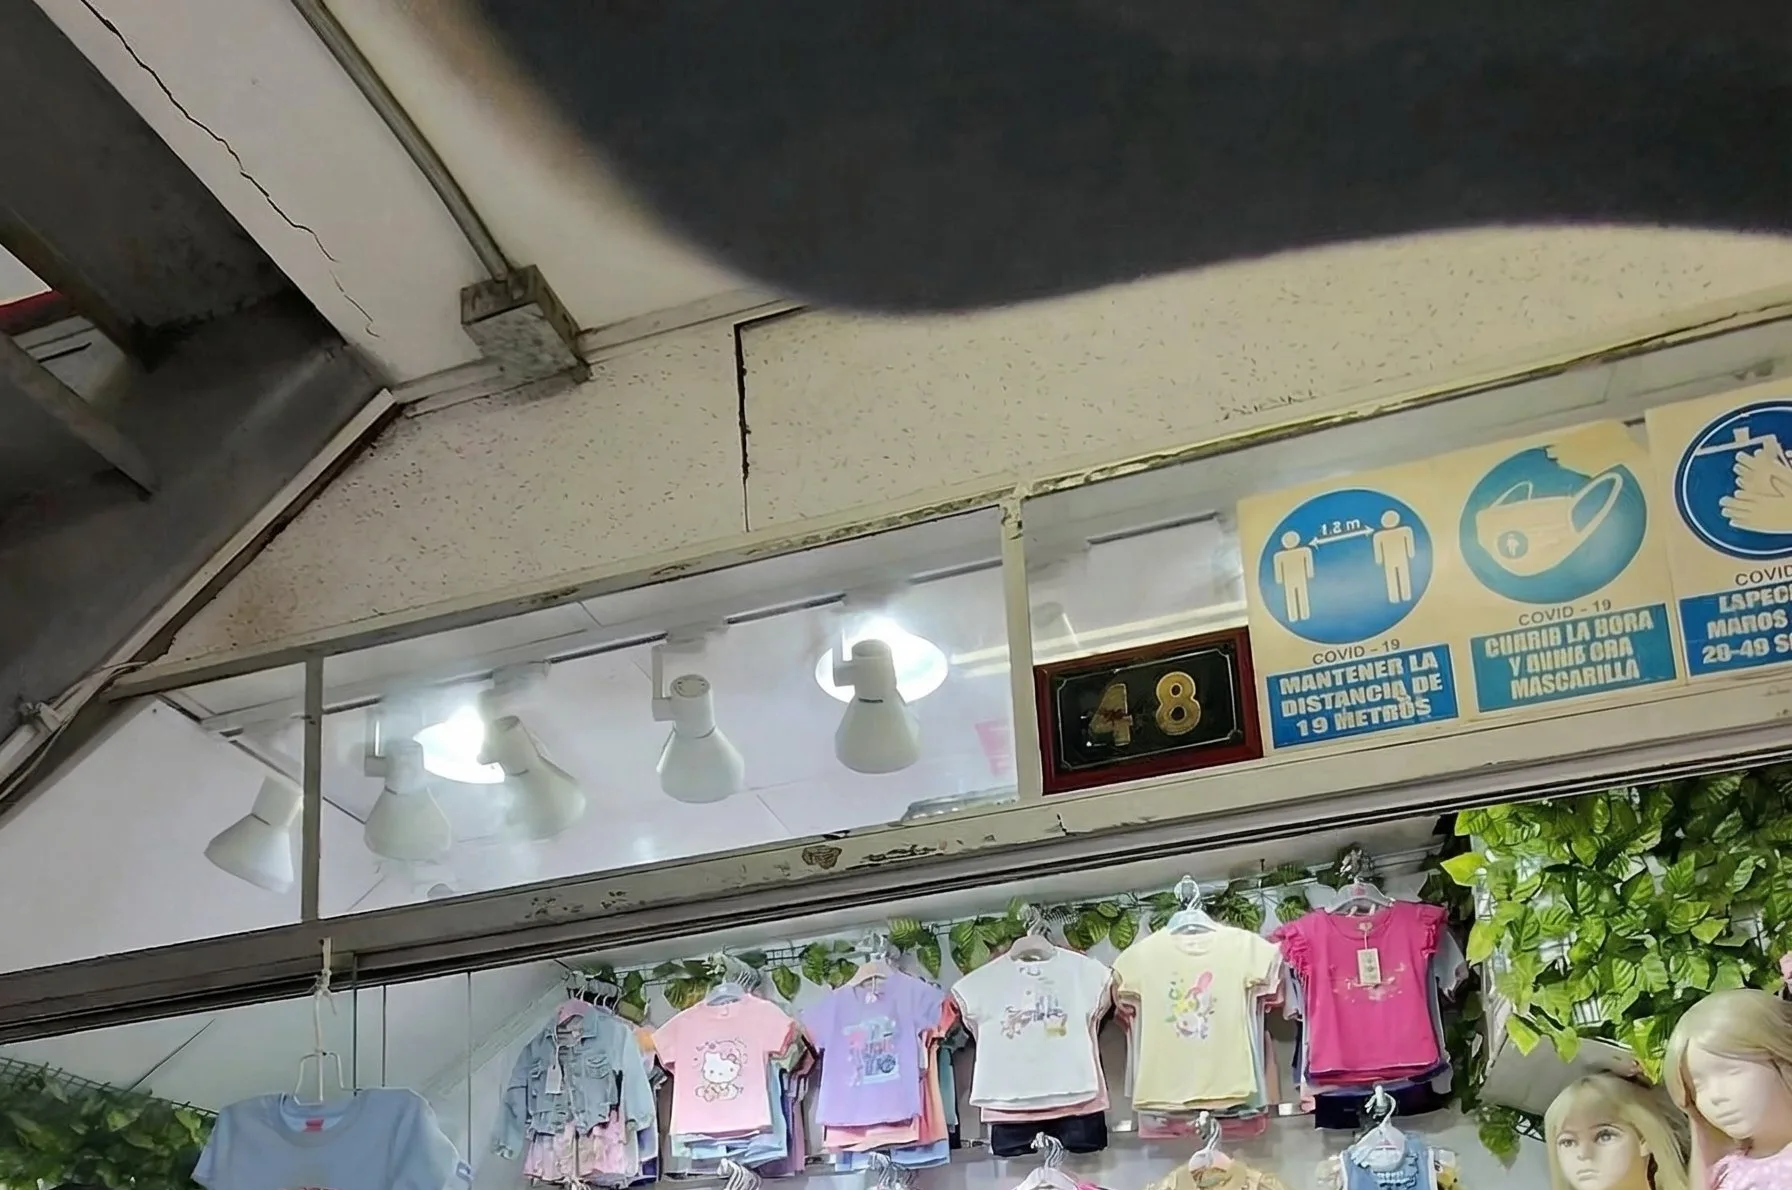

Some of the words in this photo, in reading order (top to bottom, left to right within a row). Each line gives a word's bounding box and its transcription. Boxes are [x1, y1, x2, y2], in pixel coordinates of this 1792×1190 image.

[1518, 605, 1574, 626] COVID
[1593, 599, 1612, 613] 19
[1566, 621, 1591, 644] LA
[1312, 645, 1365, 665] COVID
[1382, 638, 1400, 653] 19
[1508, 655, 1521, 677] Y
[1279, 657, 1404, 695] MANTENER
[1409, 651, 1439, 671] LA
[1510, 659, 1640, 700] MASCARILLA
[1281, 680, 1407, 717] DISTANCIA
[1411, 673, 1443, 695] DE
[1334, 697, 1432, 731] METROS
